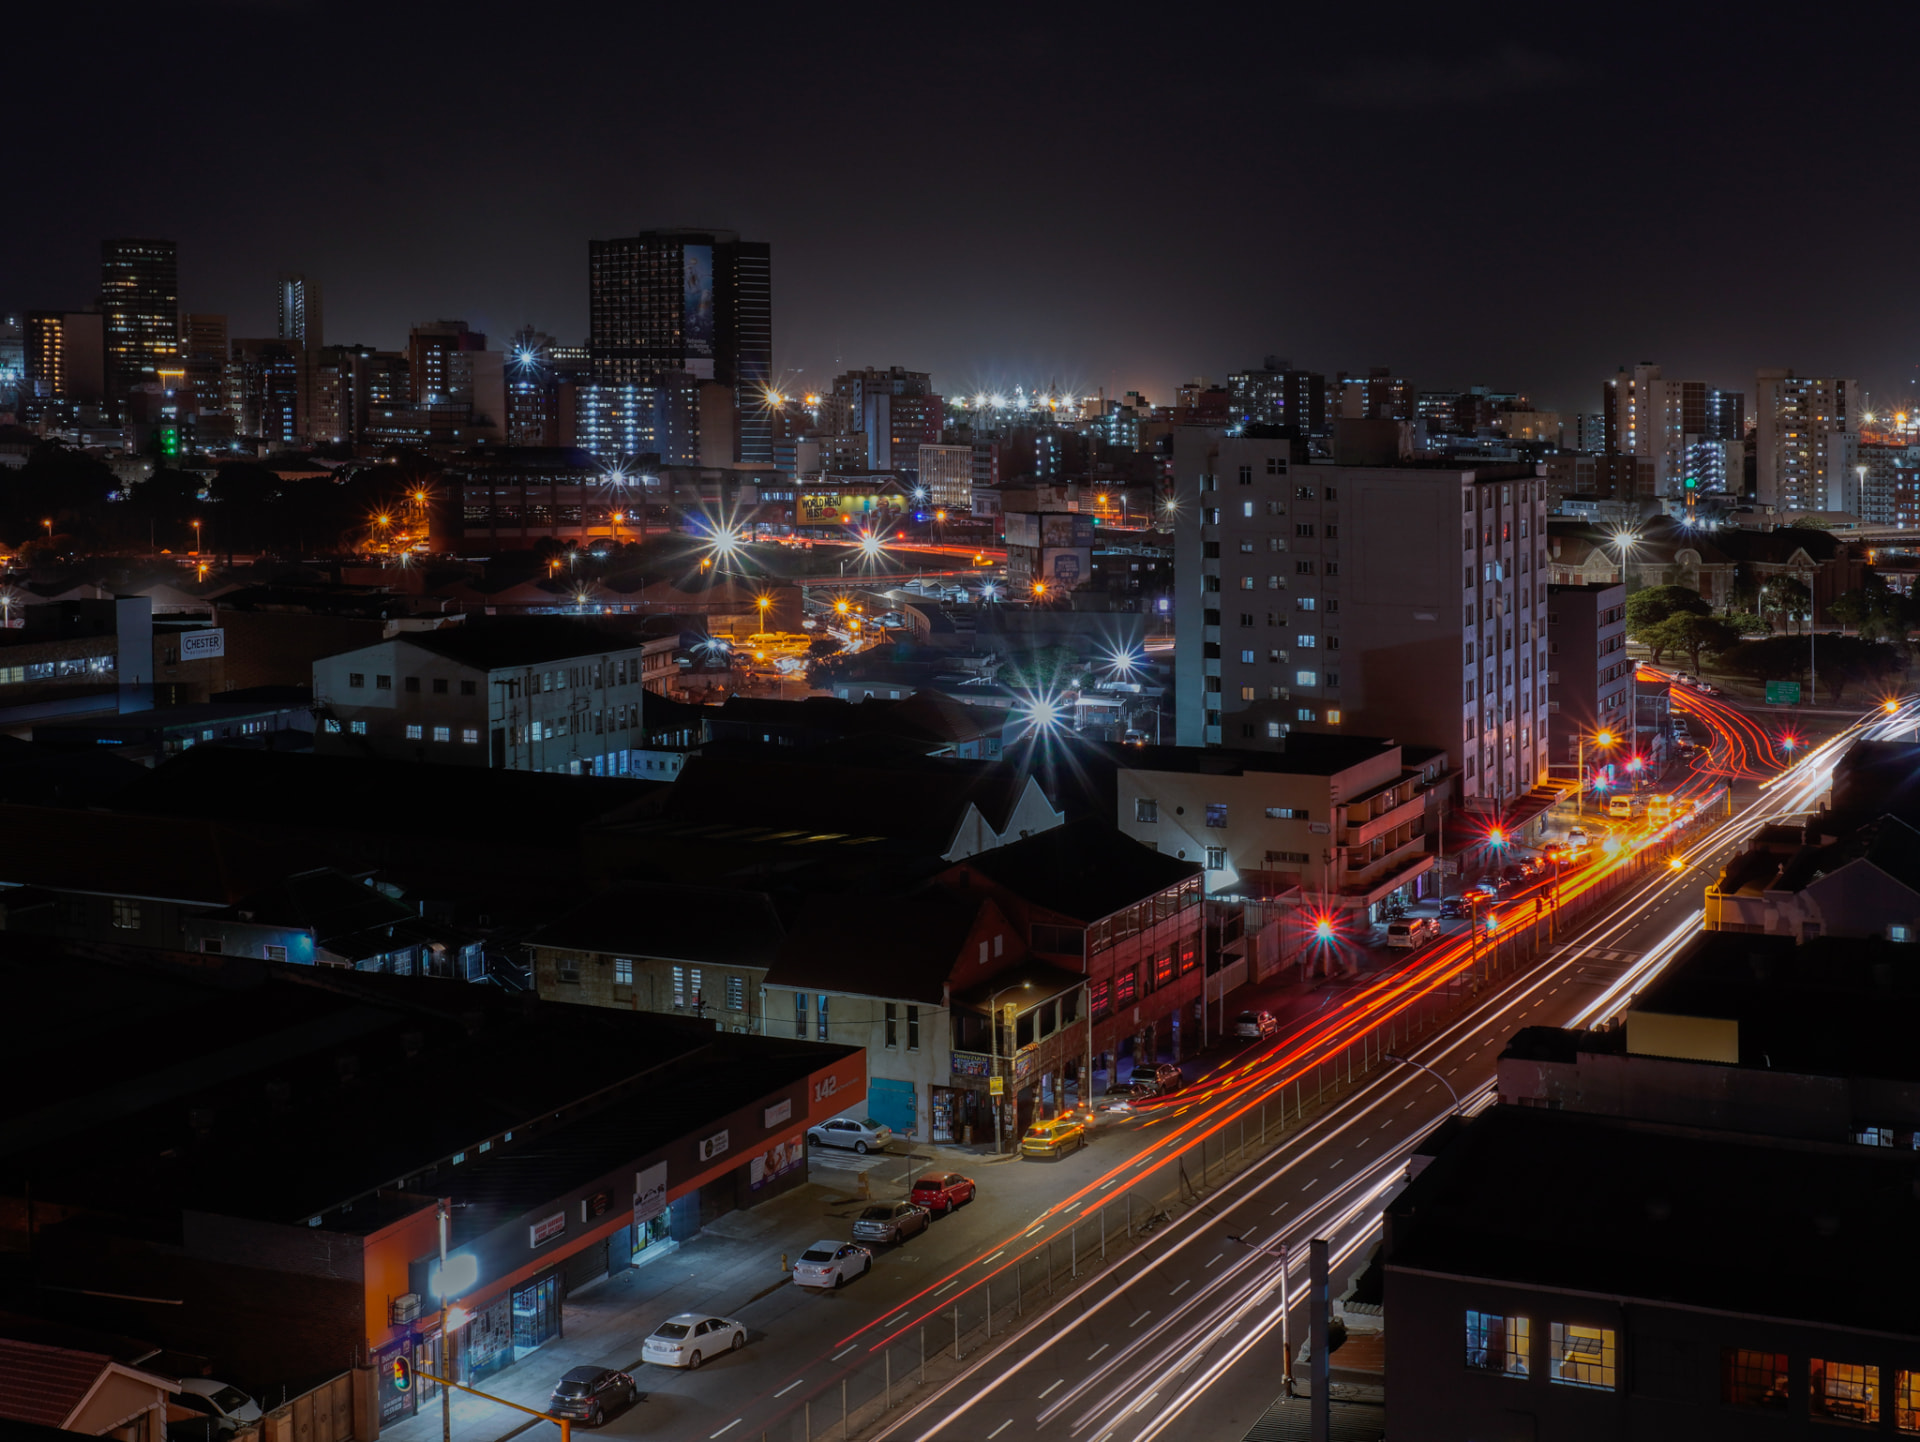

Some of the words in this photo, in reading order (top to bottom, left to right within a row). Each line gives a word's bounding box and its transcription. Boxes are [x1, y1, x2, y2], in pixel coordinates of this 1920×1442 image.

[802, 498, 824, 509] WORLD
[824, 496, 841, 507] MENU
[185, 636, 219, 650] CHESTER
[815, 1075, 837, 1103] 142
